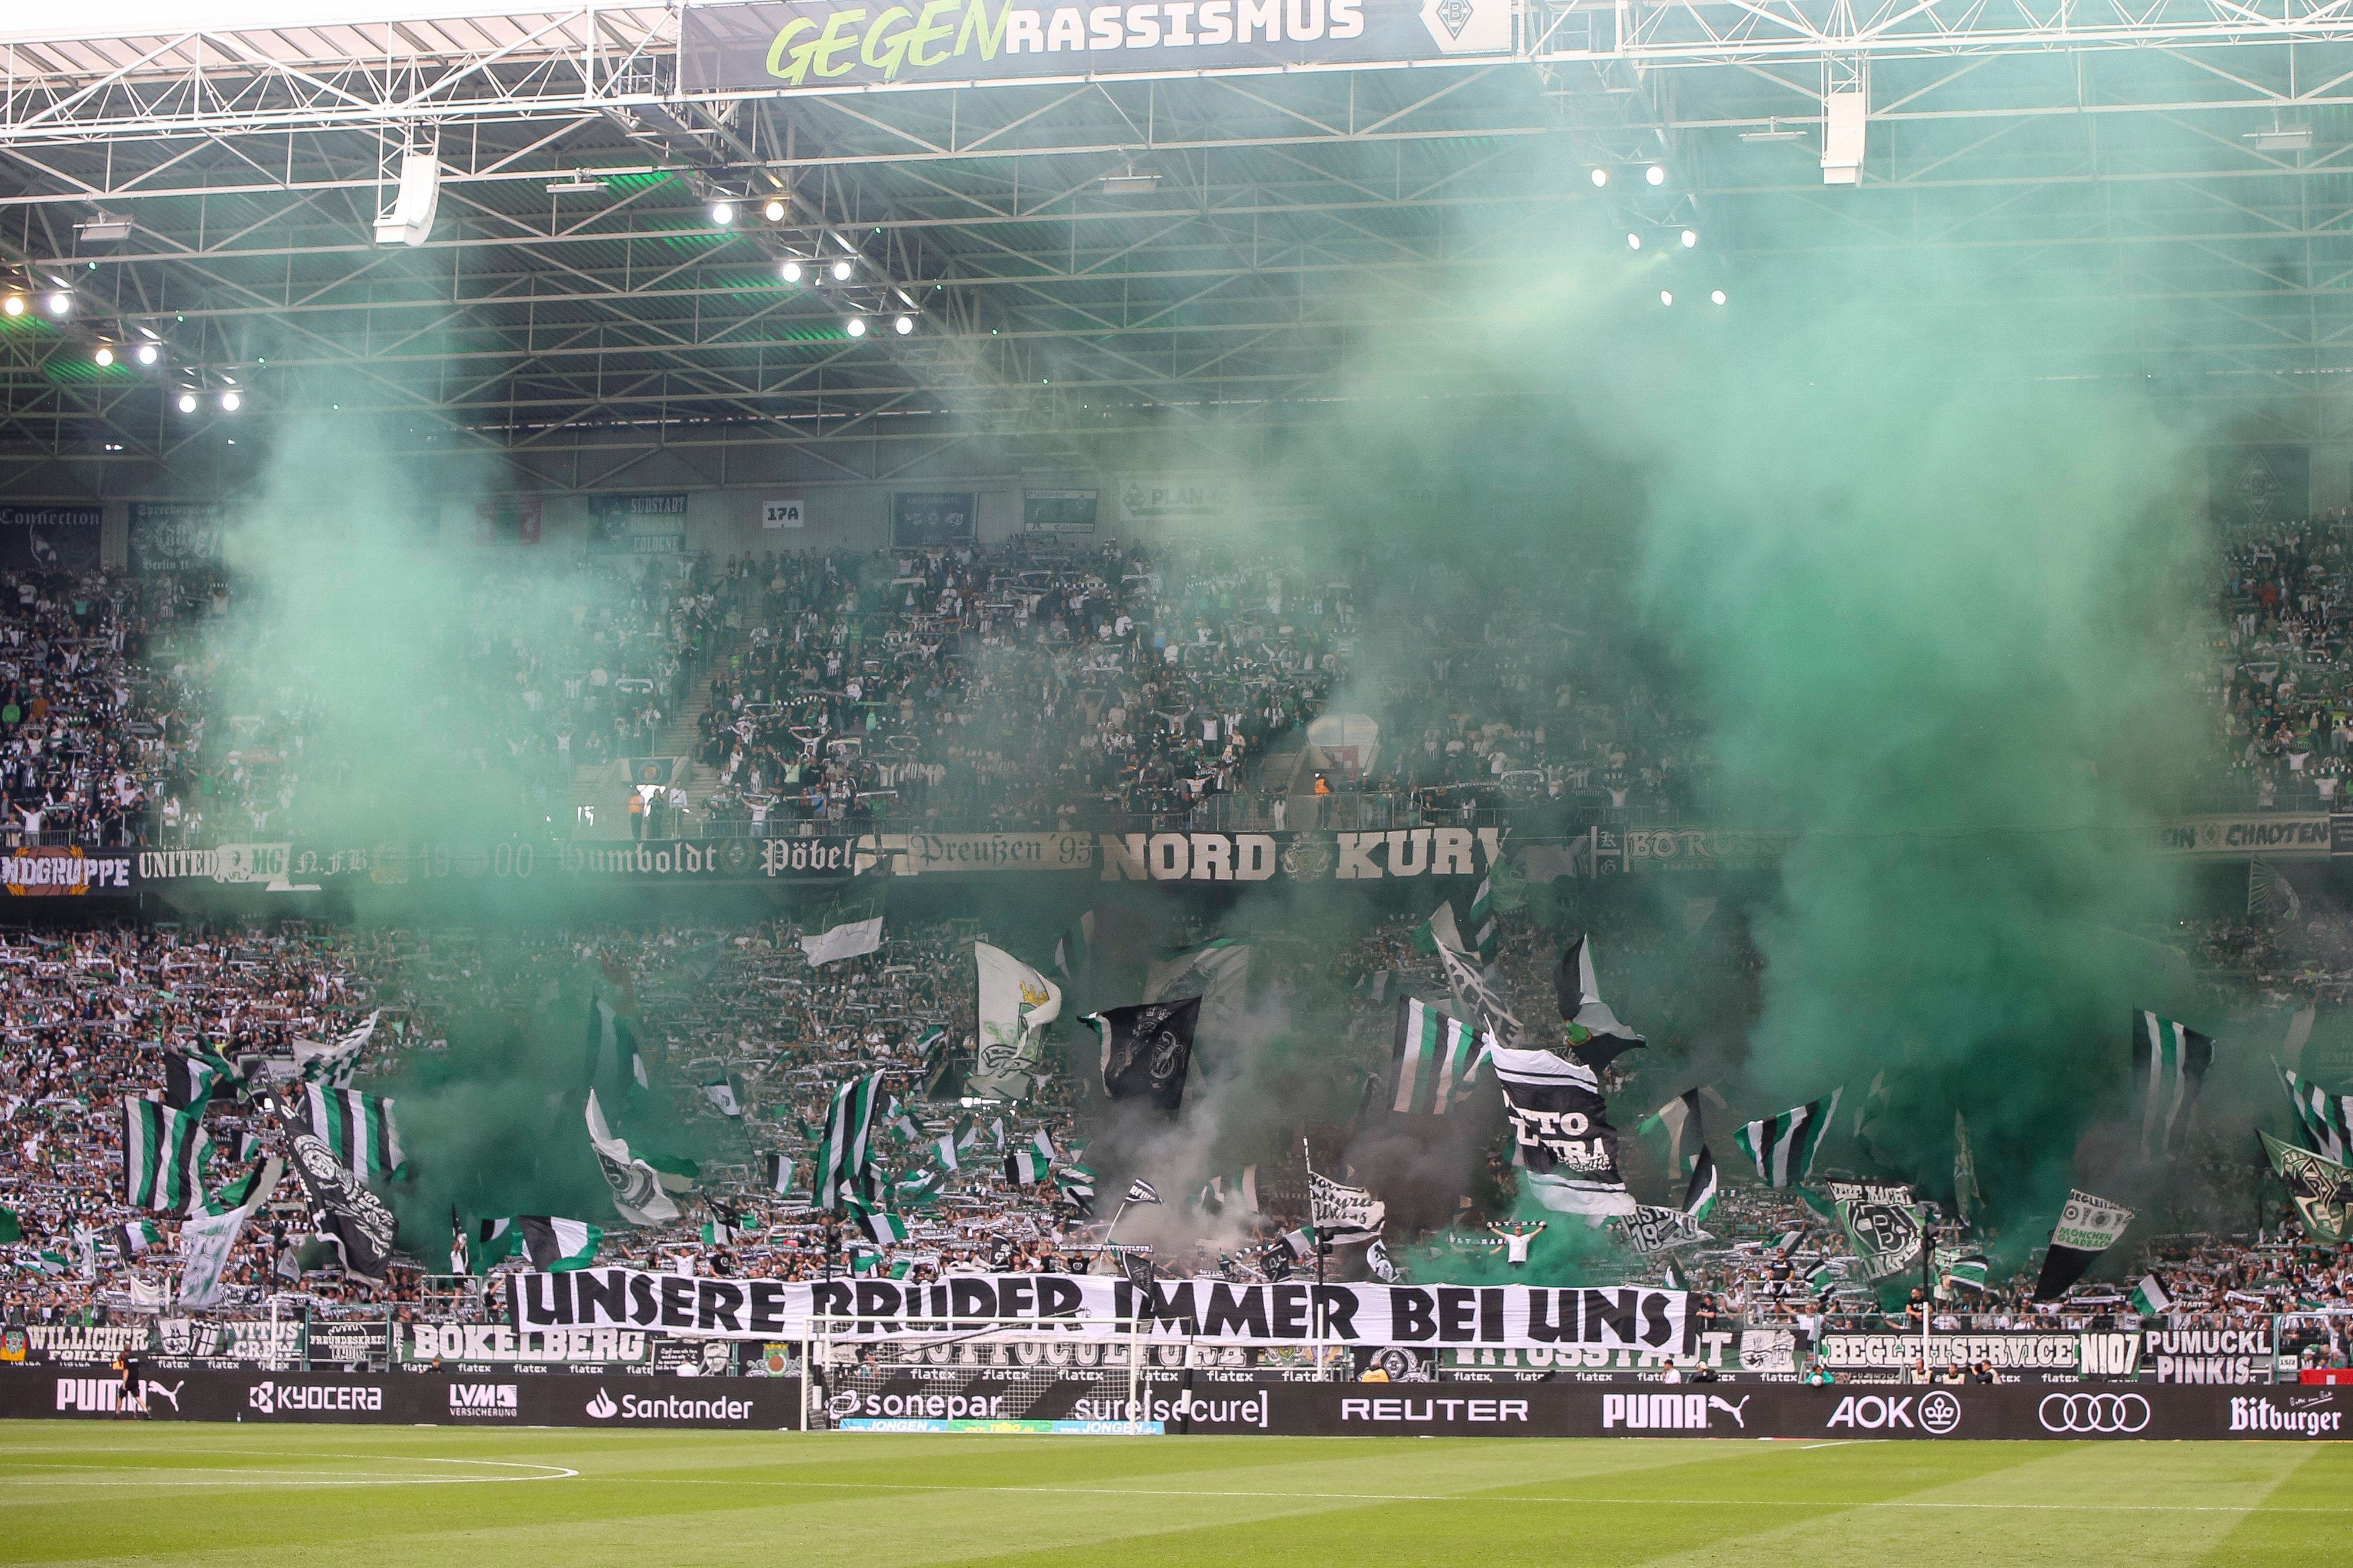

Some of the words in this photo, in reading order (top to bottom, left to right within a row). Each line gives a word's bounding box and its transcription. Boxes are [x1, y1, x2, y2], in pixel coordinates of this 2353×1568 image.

[766, 0, 1012, 85] GEGEN
[1005, 0, 1365, 54] RASSISMUS
[767, 506, 799, 521] 17A
[2226, 822, 2330, 847] CHAOTEN
[556, 840, 716, 876] Humboldt
[761, 838, 854, 876] Pöbel
[911, 833, 1042, 866] Preußen
[1100, 832, 1276, 881] NORD
[139, 849, 218, 879] UNITED
[251, 848, 284, 875] MG
[525, 1269, 786, 1332] UNSERE
[1114, 1282, 1360, 1339] IMMER
[1390, 1287, 1505, 1342] BEI
[1528, 1288, 1672, 1349] UNS
[26, 1326, 149, 1352] WILLICHER
[232, 1322, 299, 1341] VITUS
[310, 1335, 386, 1345] FREUNDESKREIS
[412, 1321, 646, 1362] BÖKELBERG
[2146, 1330, 2272, 1354] PUMUCKL
[1827, 1336, 2074, 1366] BEGLEITSERVICE
[156, 1359, 189, 1369] flatex
[207, 1359, 239, 1369] flatex
[457, 1363, 491, 1373] flatex
[513, 1363, 547, 1373] flatex
[569, 1363, 604, 1373] flatex
[910, 1368, 956, 1380] flatex
[982, 1368, 1029, 1380] flatex
[1056, 1369, 1104, 1381] flatex
[1135, 1370, 1178, 1382] flatex
[1207, 1370, 1254, 1382] flatex
[2157, 1355, 2251, 1384] PINKIS
[1454, 1372, 1491, 1382] flatex
[1575, 1372, 1612, 1382] flatex
[1760, 1372, 1798, 1382] flatex
[2042, 1373, 2079, 1383] flatex
[276, 1385, 382, 1411] KYOCERA
[449, 1383, 498, 1407] LVM
[622, 1393, 754, 1420] Santander
[865, 1393, 1002, 1420] sonepar
[449, 1407, 517, 1418] VERSICHERUNG
[1341, 1399, 1529, 1422] REUTER
[1602, 1393, 1707, 1429] PUMA
[1826, 1395, 1914, 1429] AOK
[2228, 1396, 2343, 1437] Bitburger
